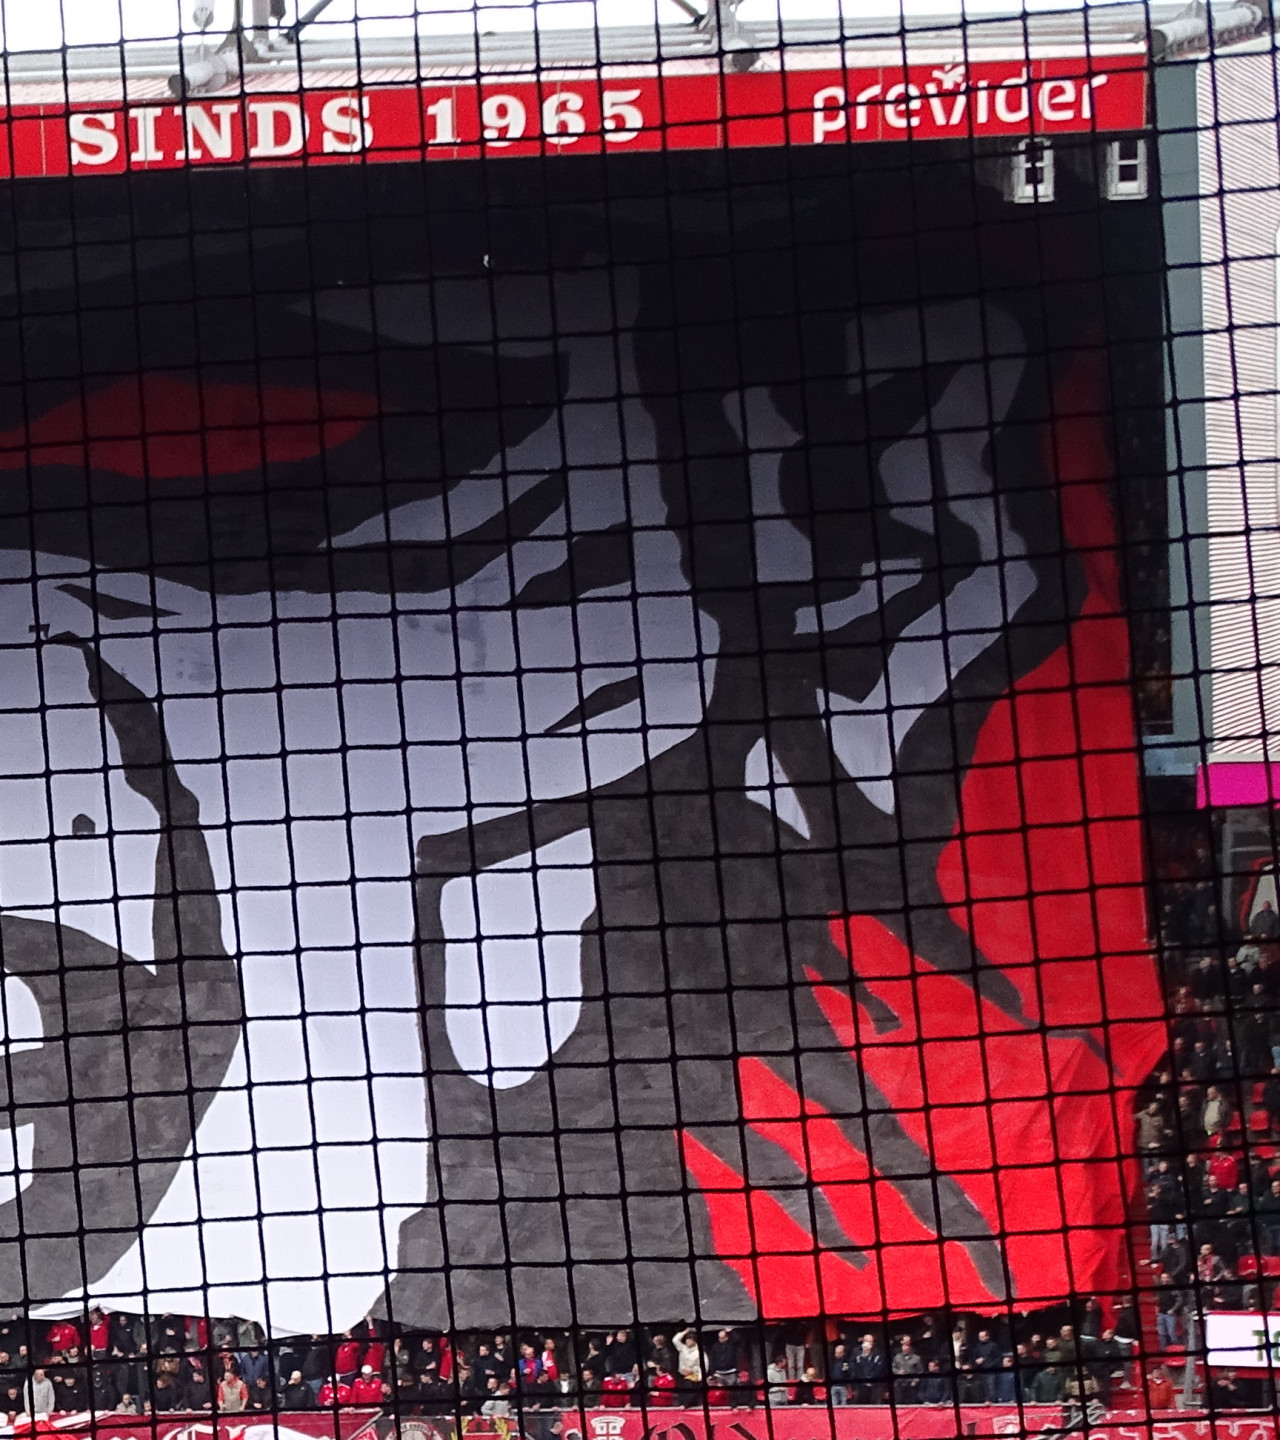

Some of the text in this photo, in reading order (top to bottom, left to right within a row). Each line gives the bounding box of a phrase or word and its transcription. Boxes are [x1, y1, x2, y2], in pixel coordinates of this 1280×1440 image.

[69, 89, 645, 167] SINDS 1965
[813, 64, 1109, 144] previder
